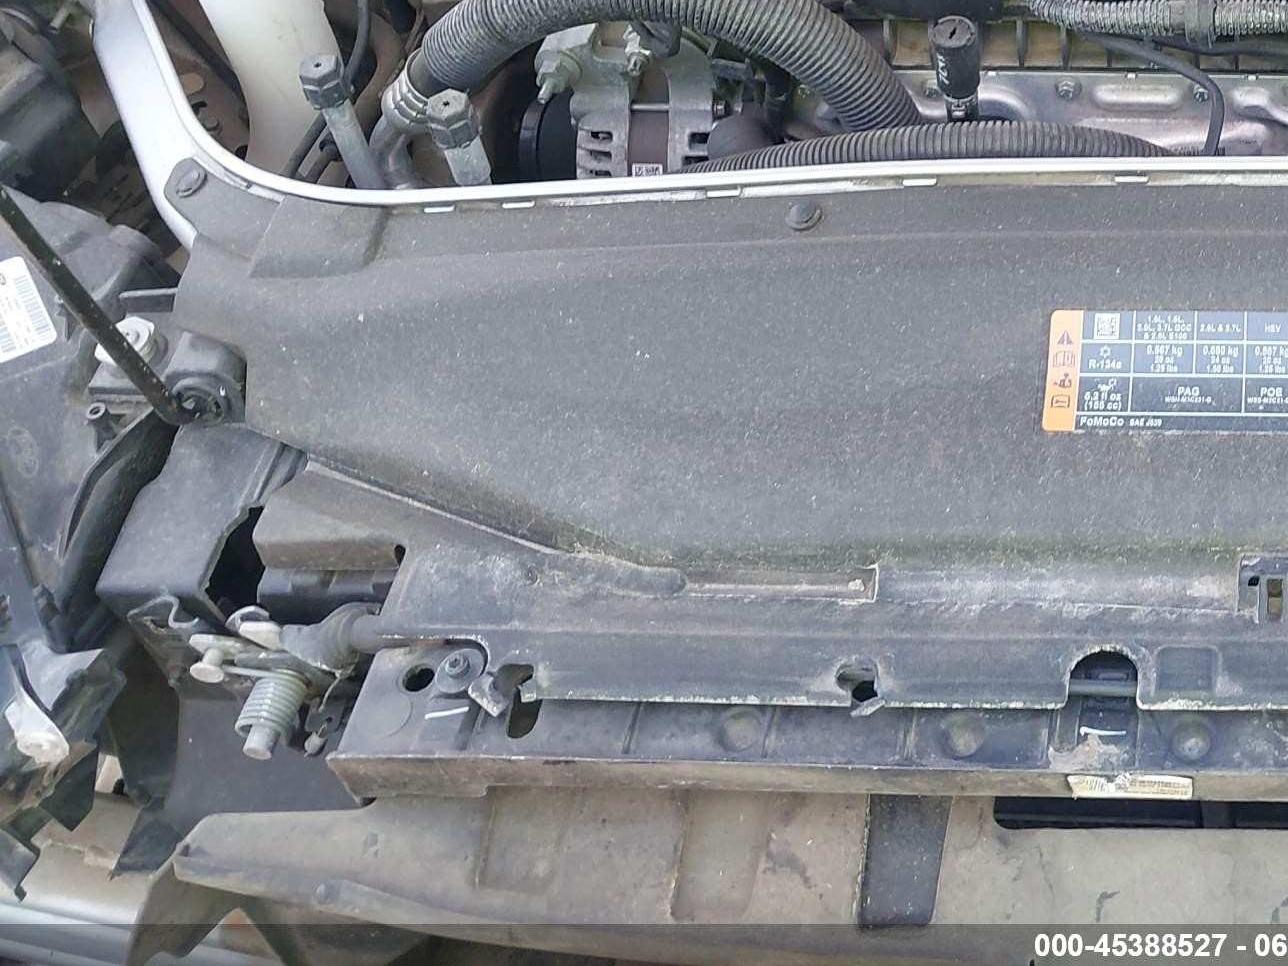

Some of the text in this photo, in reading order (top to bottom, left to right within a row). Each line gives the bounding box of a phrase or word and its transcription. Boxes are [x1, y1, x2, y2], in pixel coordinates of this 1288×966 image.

[1264, 323, 1281, 333] HEV
[1171, 345, 1183, 357] kg
[1227, 345, 1239, 357] kg
[1088, 359, 1122, 369] R-134a
[1177, 386, 1200, 396] PAG
[1260, 387, 1283, 397] POE
[1080, 416, 1124, 427] FoMoCo
